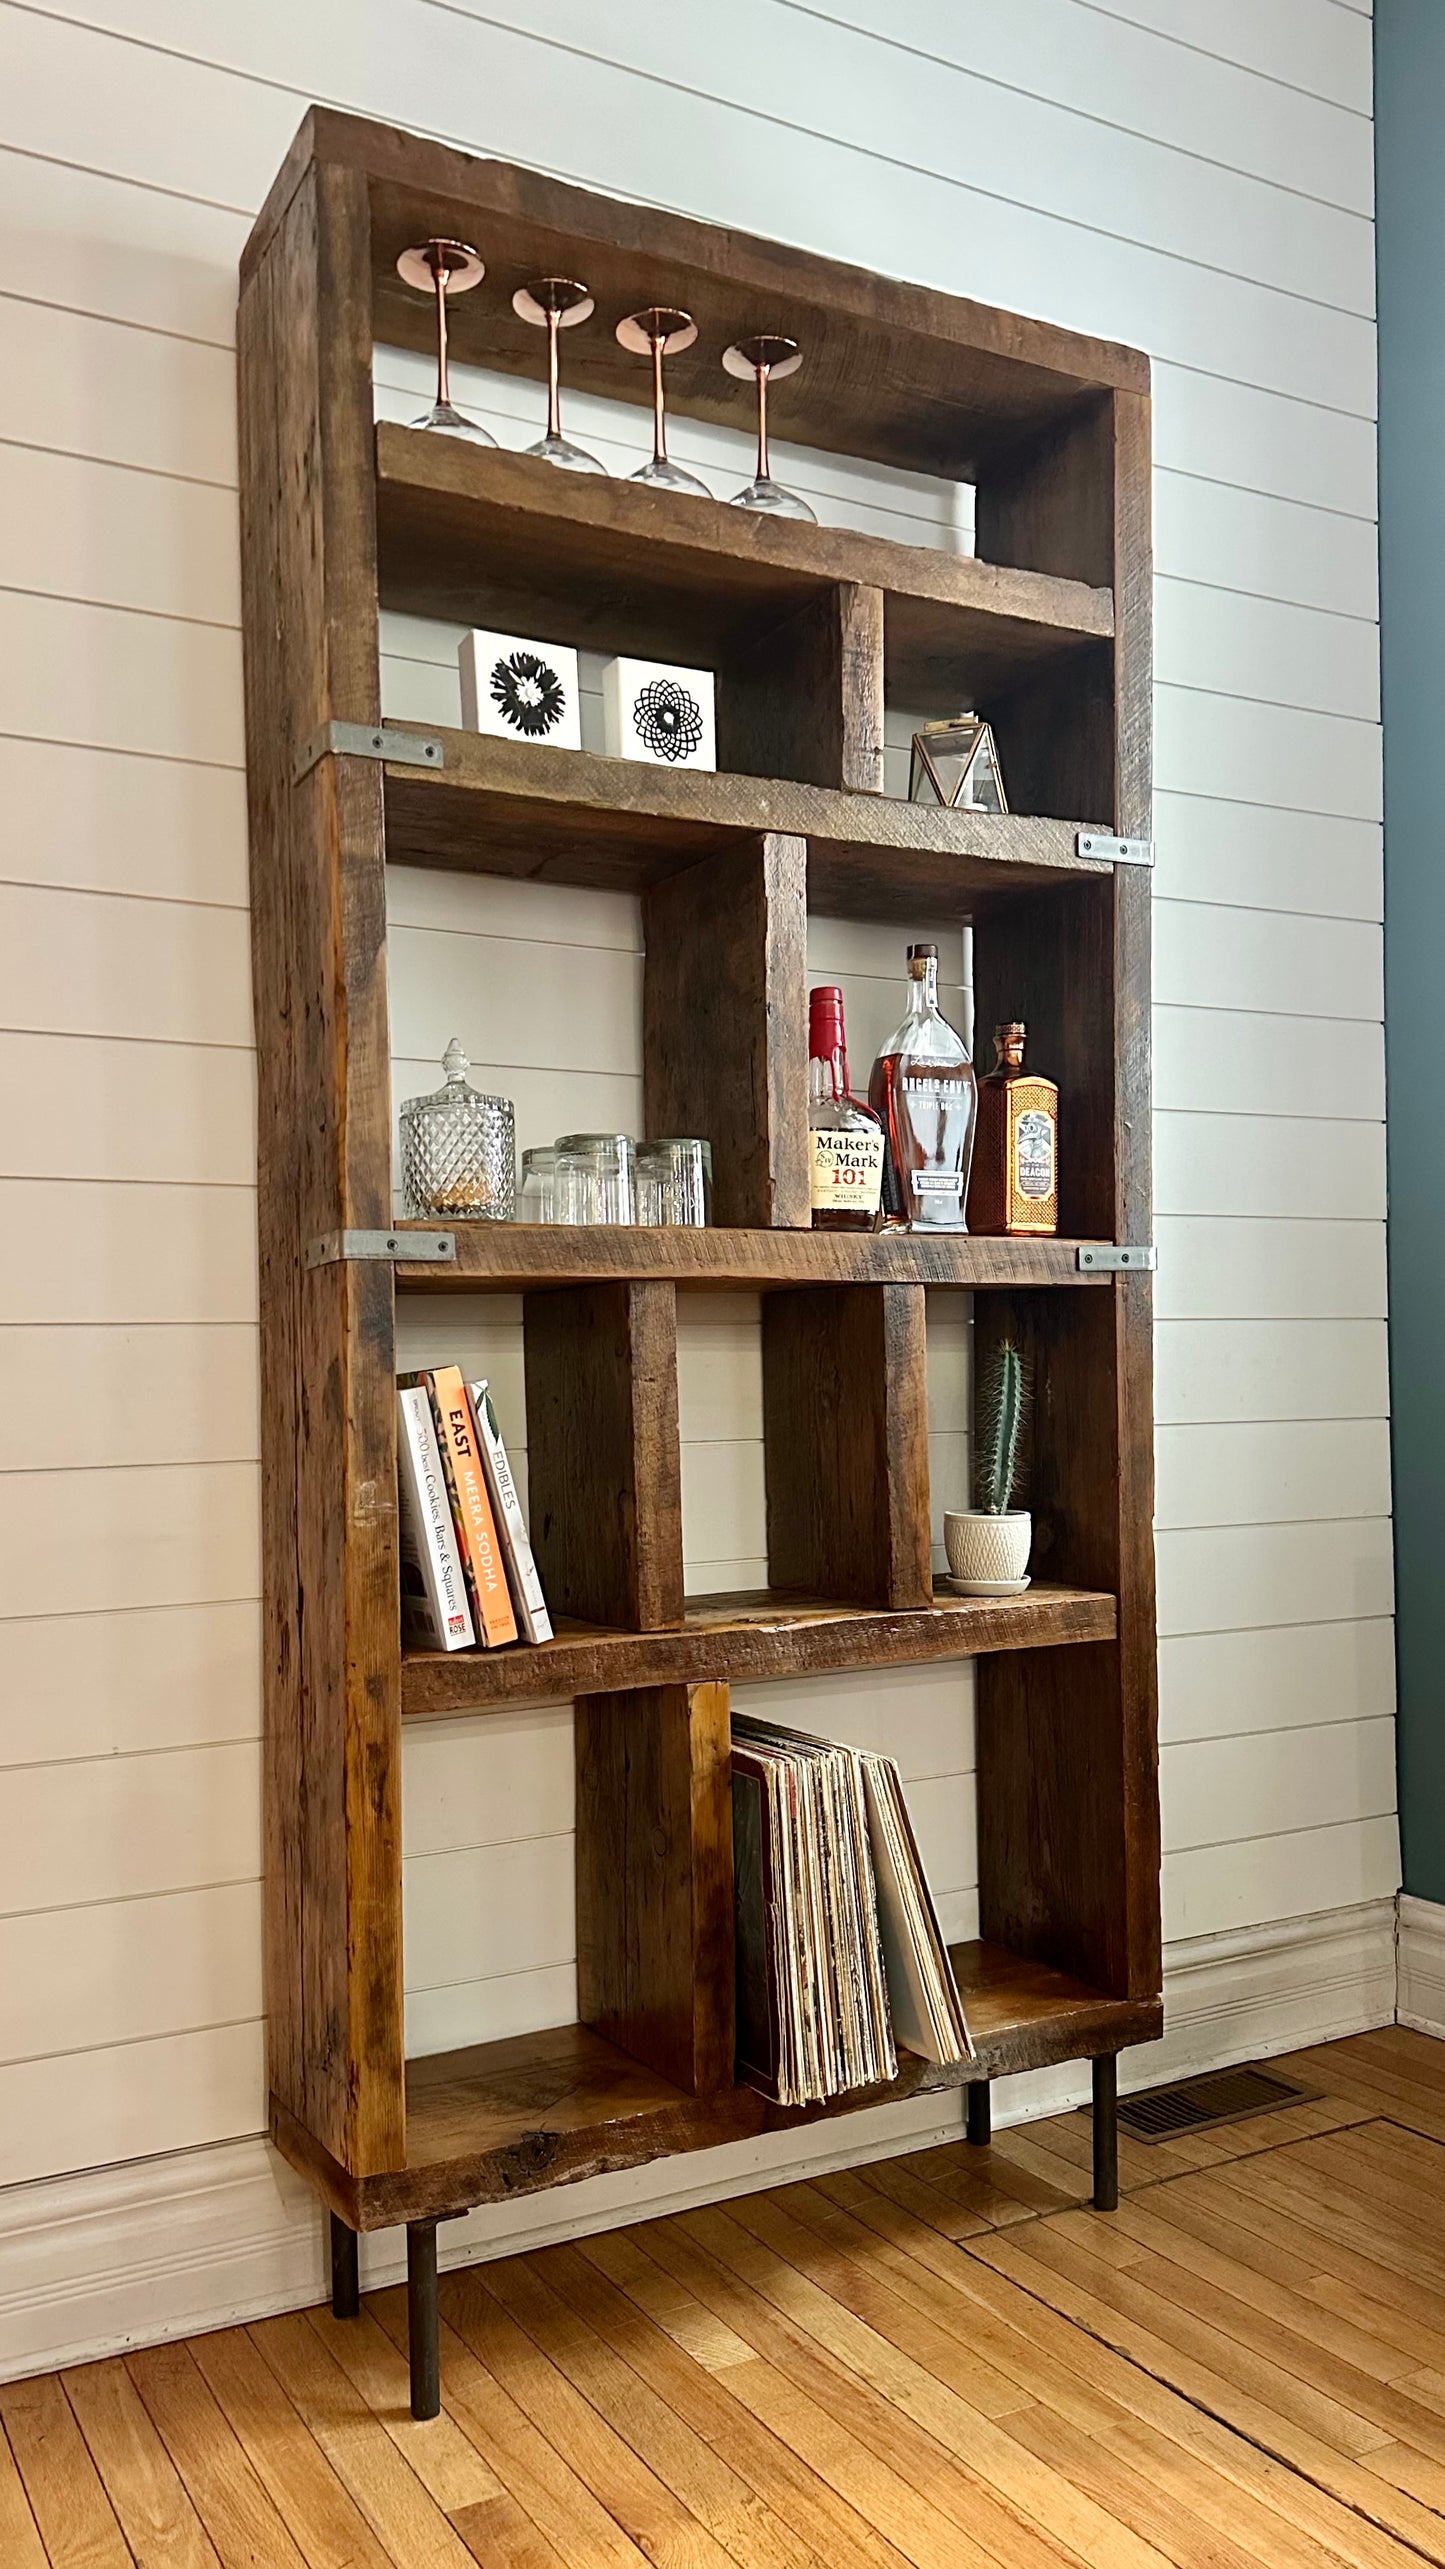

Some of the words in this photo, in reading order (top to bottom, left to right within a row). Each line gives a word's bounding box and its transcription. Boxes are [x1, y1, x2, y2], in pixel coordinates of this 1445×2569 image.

[943, 1079, 969, 1095] ENVY
[816, 1136, 880, 1152] Maker's
[835, 1153, 879, 1168] Mark
[832, 1168, 867, 1186] 101
[1019, 1167, 1051, 1178] DEACON
[416, 1428, 431, 1452] 500
[449, 1409, 472, 1458] EAST
[420, 1453, 431, 1473] best
[492, 1450, 516, 1510] EDIBLES
[425, 1474, 442, 1524] Cookies,
[434, 1525, 446, 1550] Bars
[463, 1471, 486, 1527] MEERA
[476, 1532, 499, 1593] SODHA
[439, 1552, 451, 1562] &
[441, 1566, 457, 1611] Squares
[449, 1623, 467, 1635] ROSE
